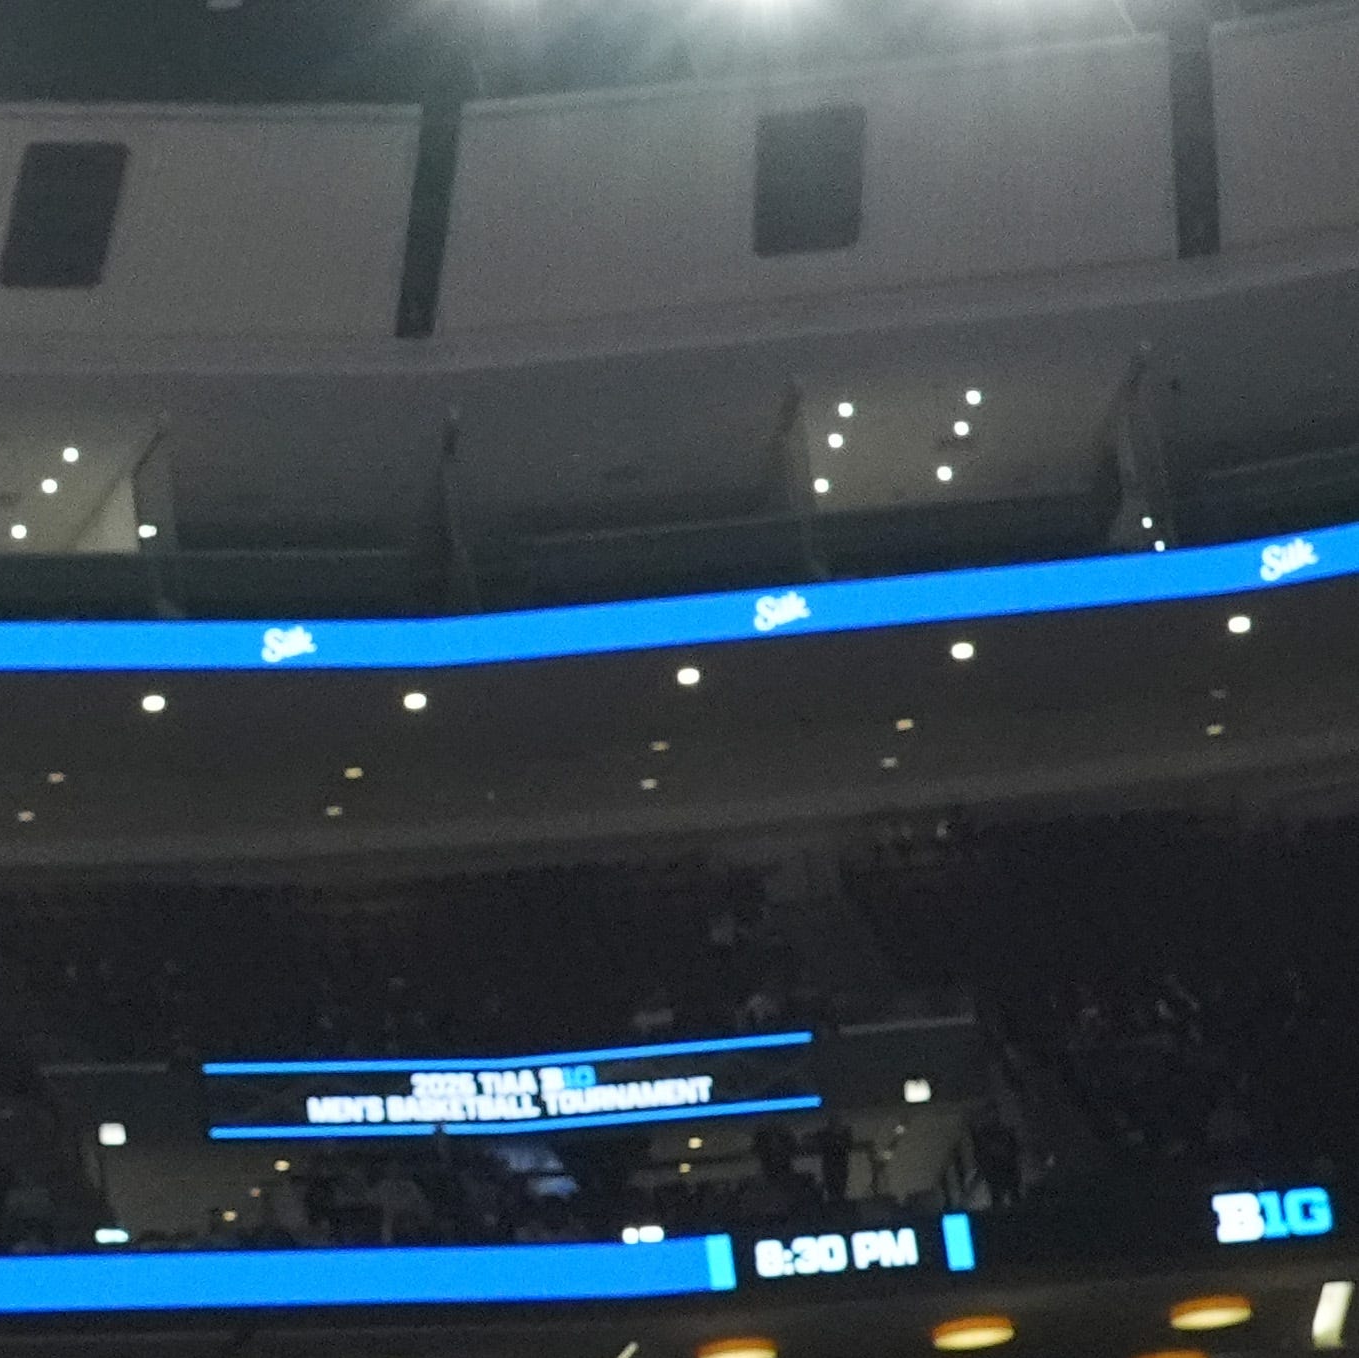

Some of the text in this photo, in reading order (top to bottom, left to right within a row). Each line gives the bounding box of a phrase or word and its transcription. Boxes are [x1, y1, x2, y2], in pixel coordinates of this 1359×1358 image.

[386, 1094, 542, 1122] BASKETBALL
[545, 1075, 714, 1116] TOURNAMENT
[851, 1227, 919, 1270] PM
